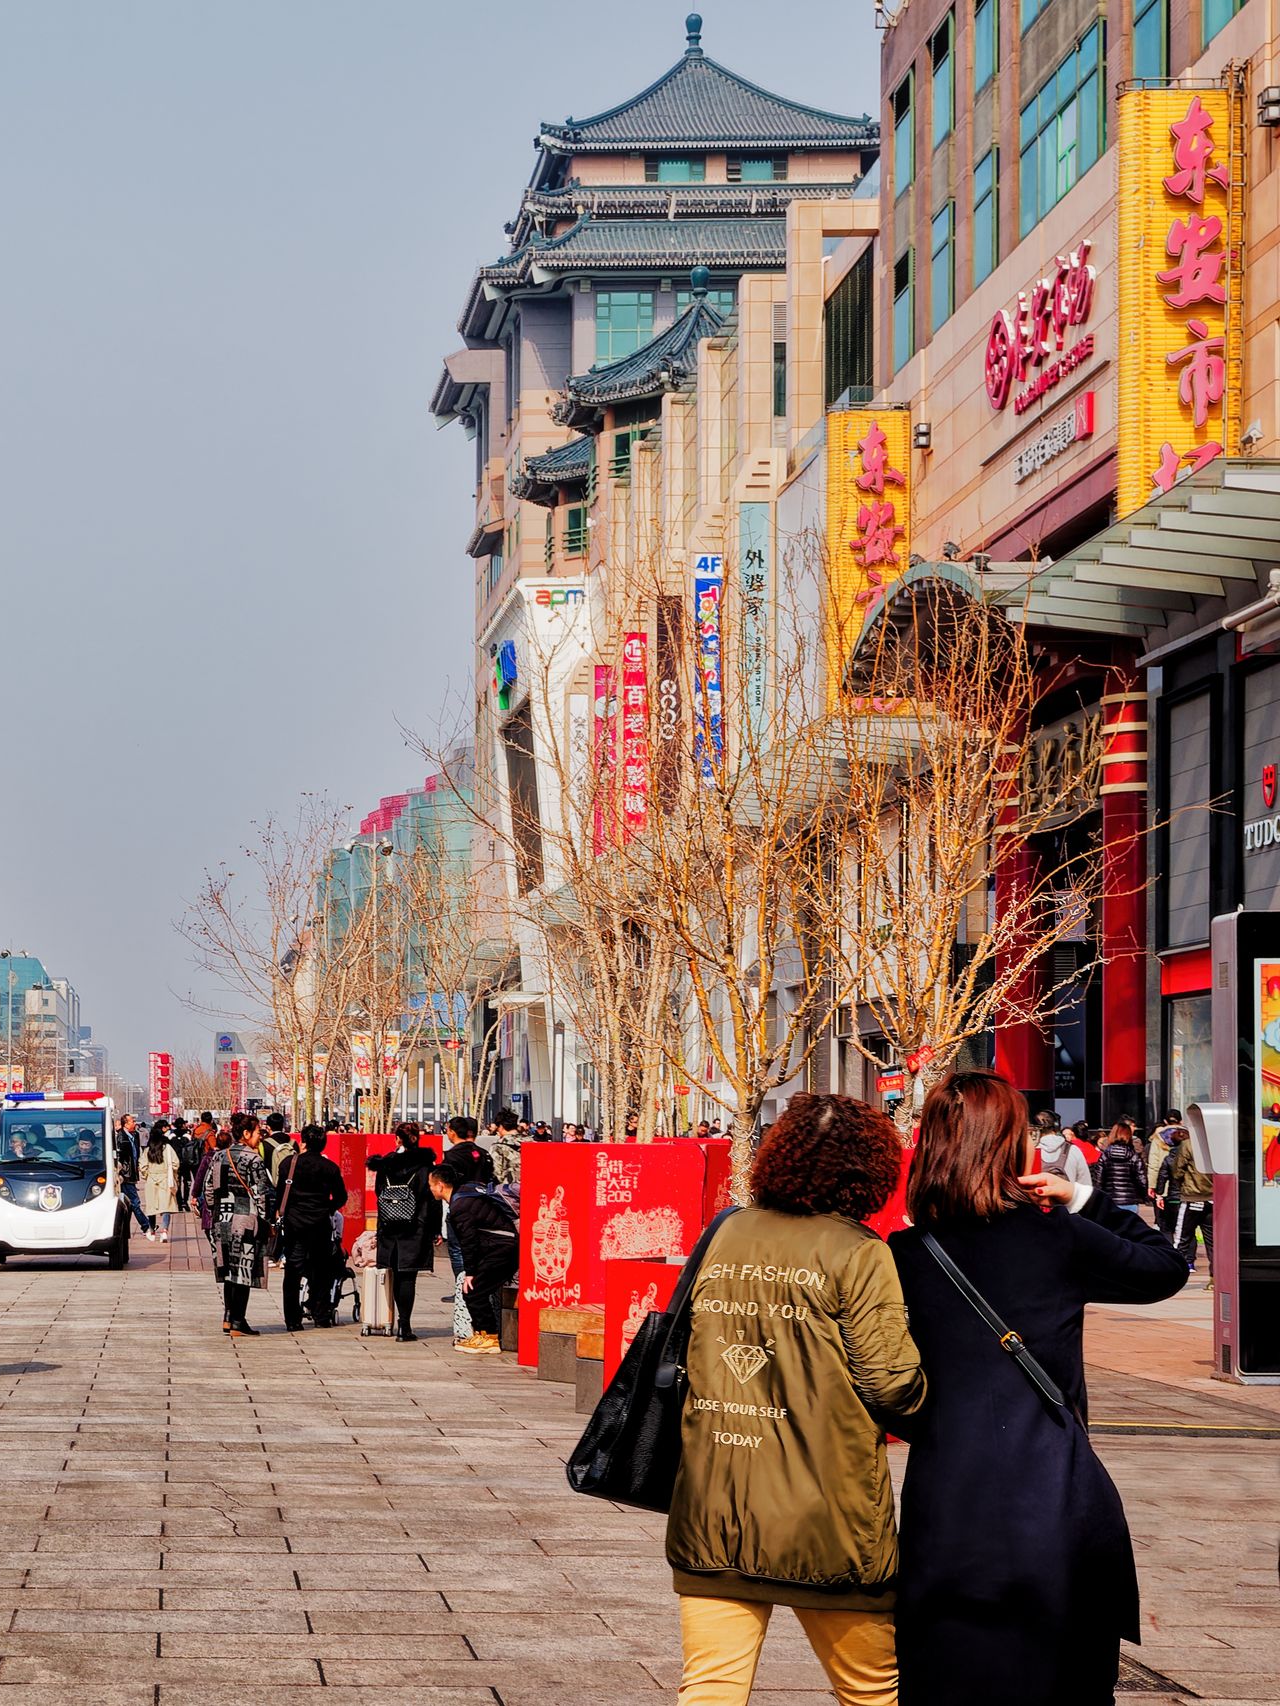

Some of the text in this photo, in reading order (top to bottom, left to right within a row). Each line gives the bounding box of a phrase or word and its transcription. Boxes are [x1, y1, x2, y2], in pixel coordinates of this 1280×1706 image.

[696, 556, 721, 572] 4F
[744, 549, 764, 616] 外婆家
[536, 589, 584, 611] apm
[754, 685, 762, 707] HOME
[607, 1190, 632, 1203] 2019
[740, 1264, 827, 1291] FASHION
[767, 1303, 808, 1321] YOU
[693, 1399, 720, 1412] LOSE
[711, 1431, 763, 1448] TODAY
